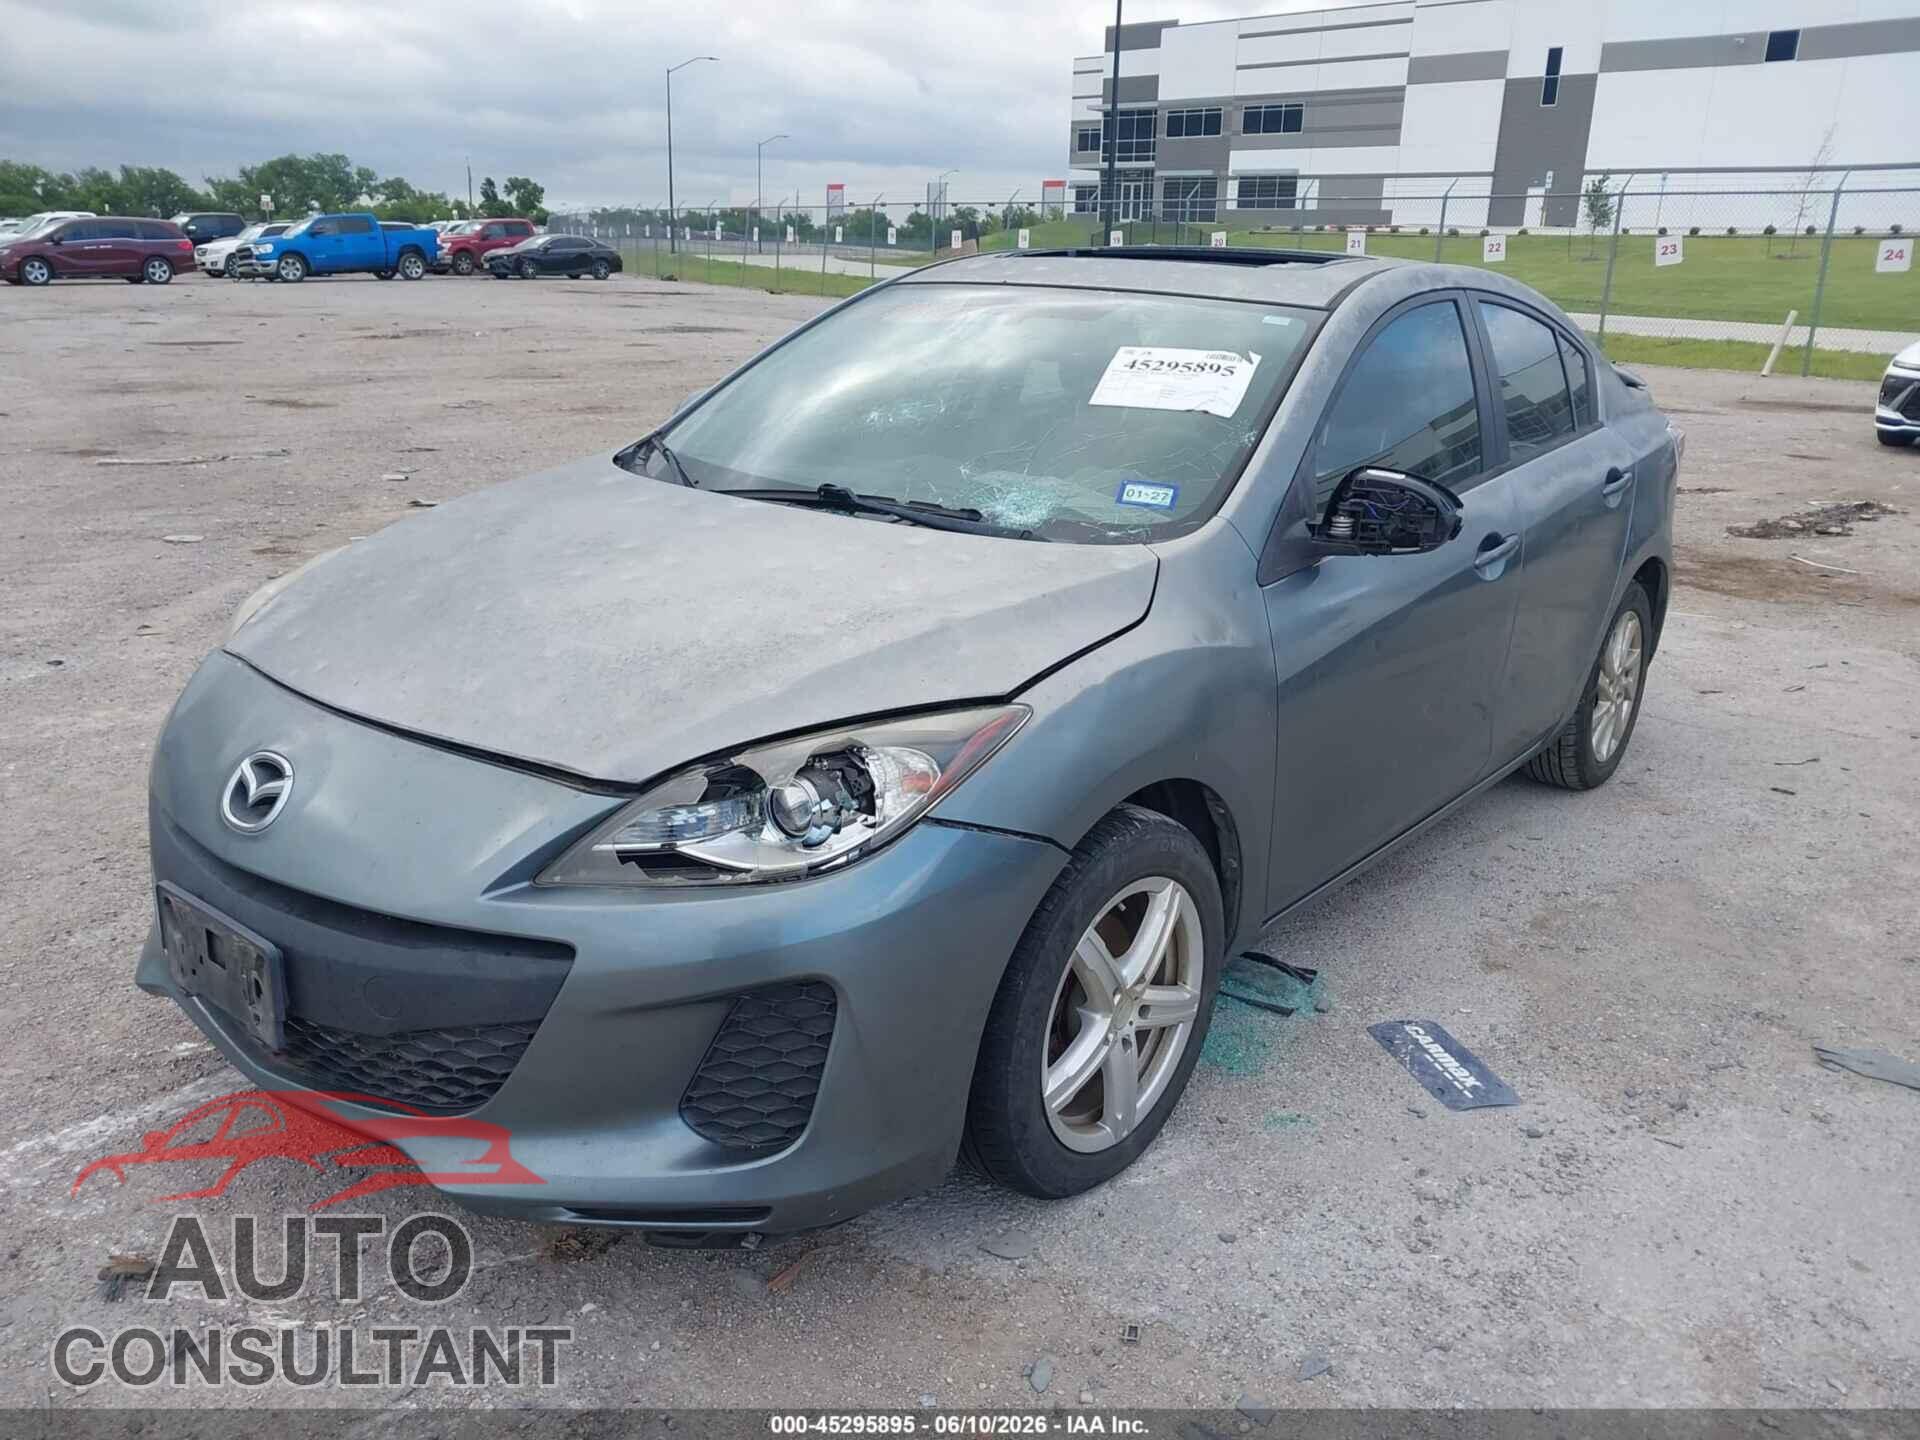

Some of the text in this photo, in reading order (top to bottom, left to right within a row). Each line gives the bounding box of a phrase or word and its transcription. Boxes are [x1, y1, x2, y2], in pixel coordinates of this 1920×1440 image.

[1214, 238, 1224, 247] 20
[1350, 239, 1361, 248] 21
[1488, 242, 1502, 253] 22
[1660, 244, 1678, 256] 23
[1883, 248, 1905, 261] 24
[1123, 358, 1237, 377] 45295895
